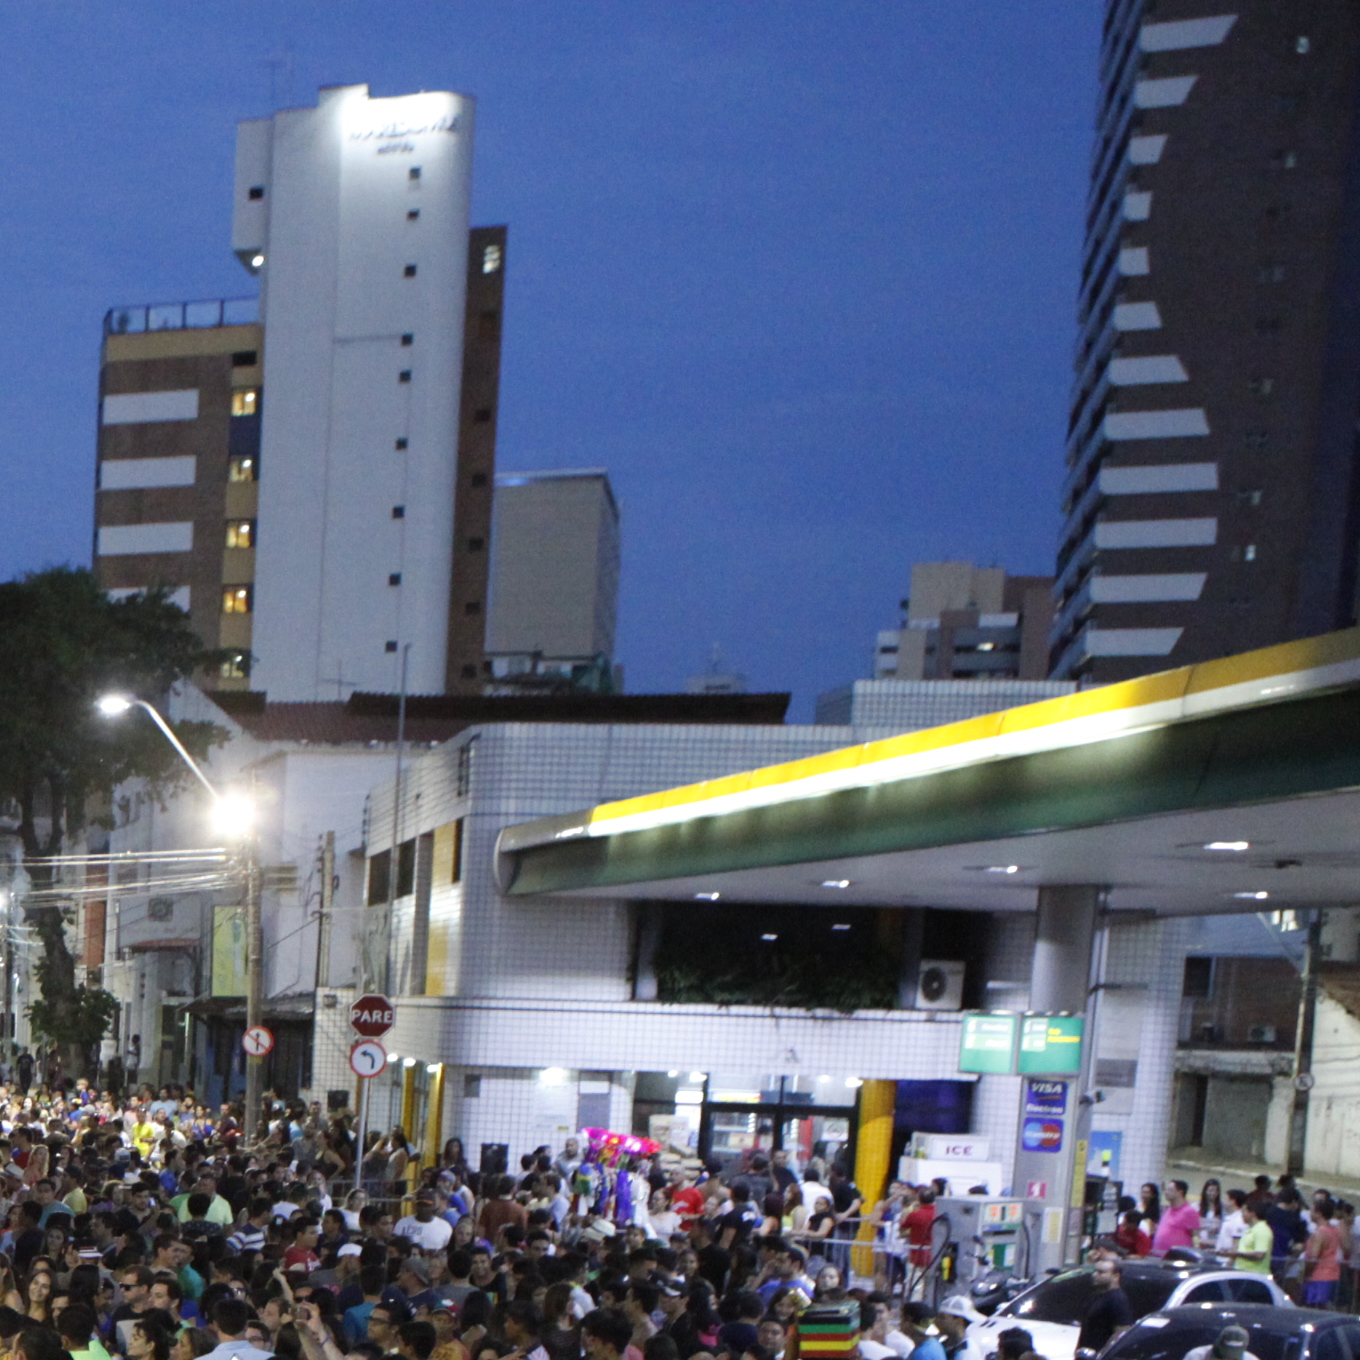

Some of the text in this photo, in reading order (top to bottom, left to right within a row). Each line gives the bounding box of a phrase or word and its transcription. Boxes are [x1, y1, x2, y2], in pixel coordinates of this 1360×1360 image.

[351, 1009, 393, 1024] PARE
[1032, 1082, 1064, 1094] VISA
[945, 1146, 973, 1156] ICE
